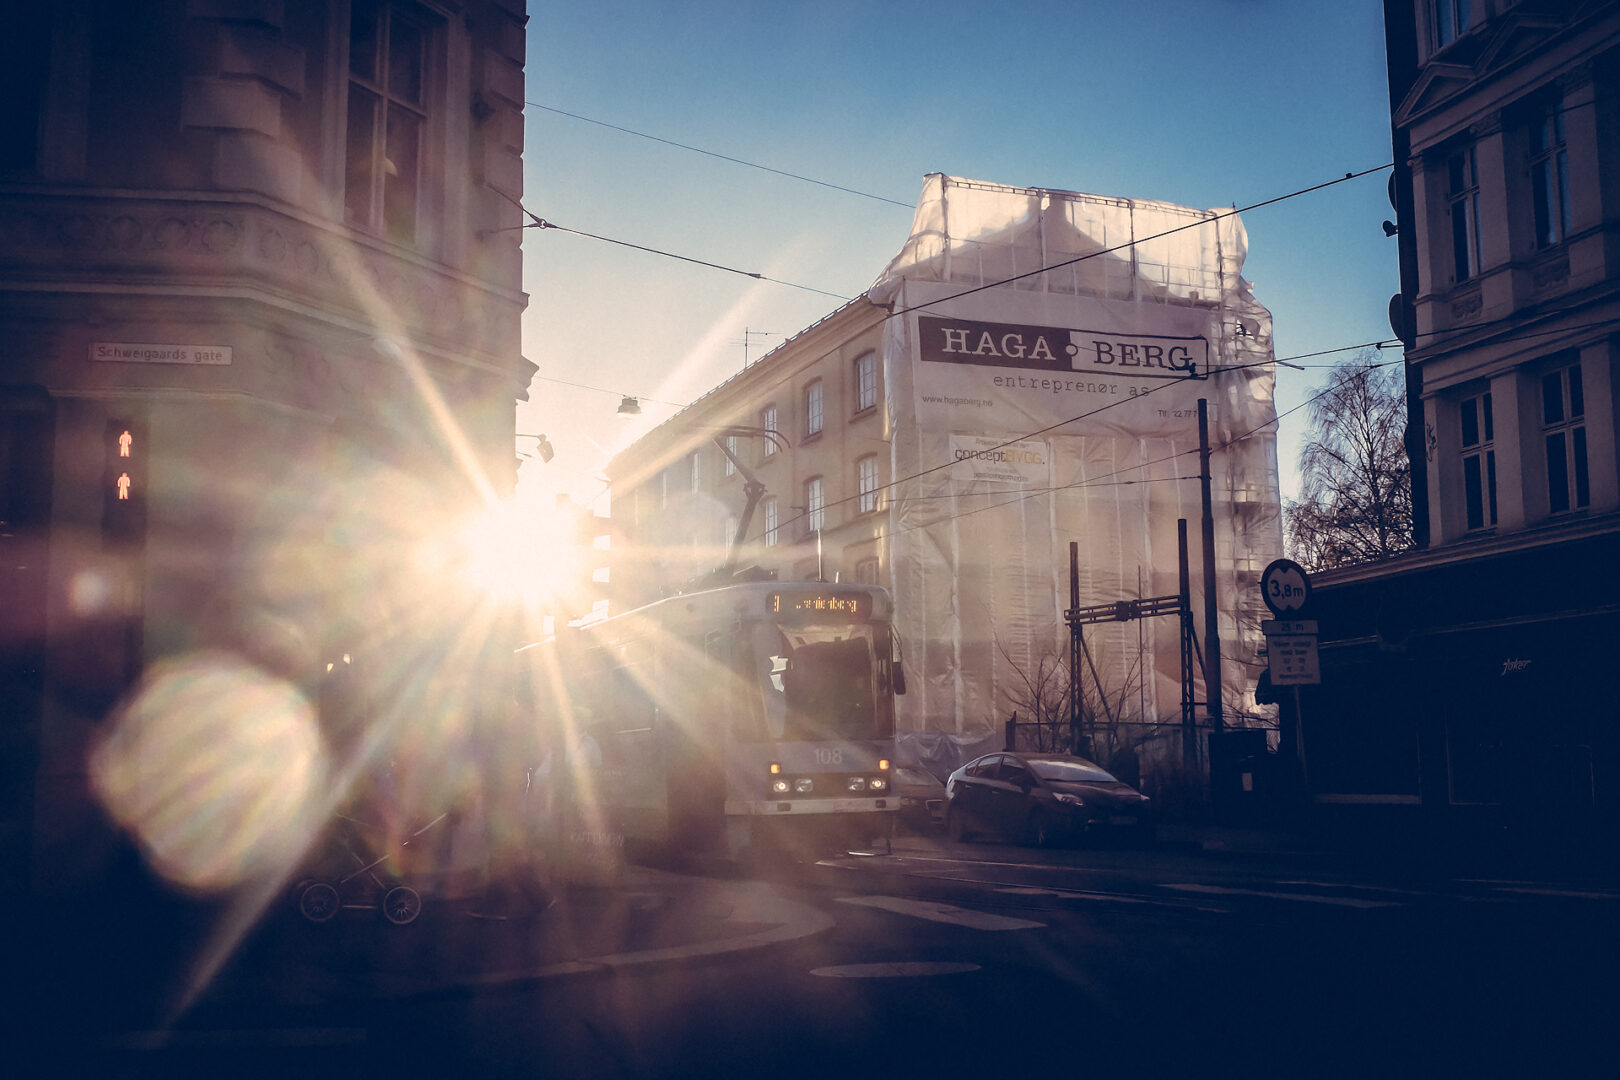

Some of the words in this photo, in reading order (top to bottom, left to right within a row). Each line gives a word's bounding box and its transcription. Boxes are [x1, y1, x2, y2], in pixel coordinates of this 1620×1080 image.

[97, 346, 187, 361] Schweigaards
[194, 351, 223, 362] gate
[941, 327, 1056, 361] HAGA
[1092, 340, 1193, 371] BERG
[993, 374, 1118, 395] entreprenør
[1129, 386, 1150, 397] as
[815, 748, 842, 765] 108
